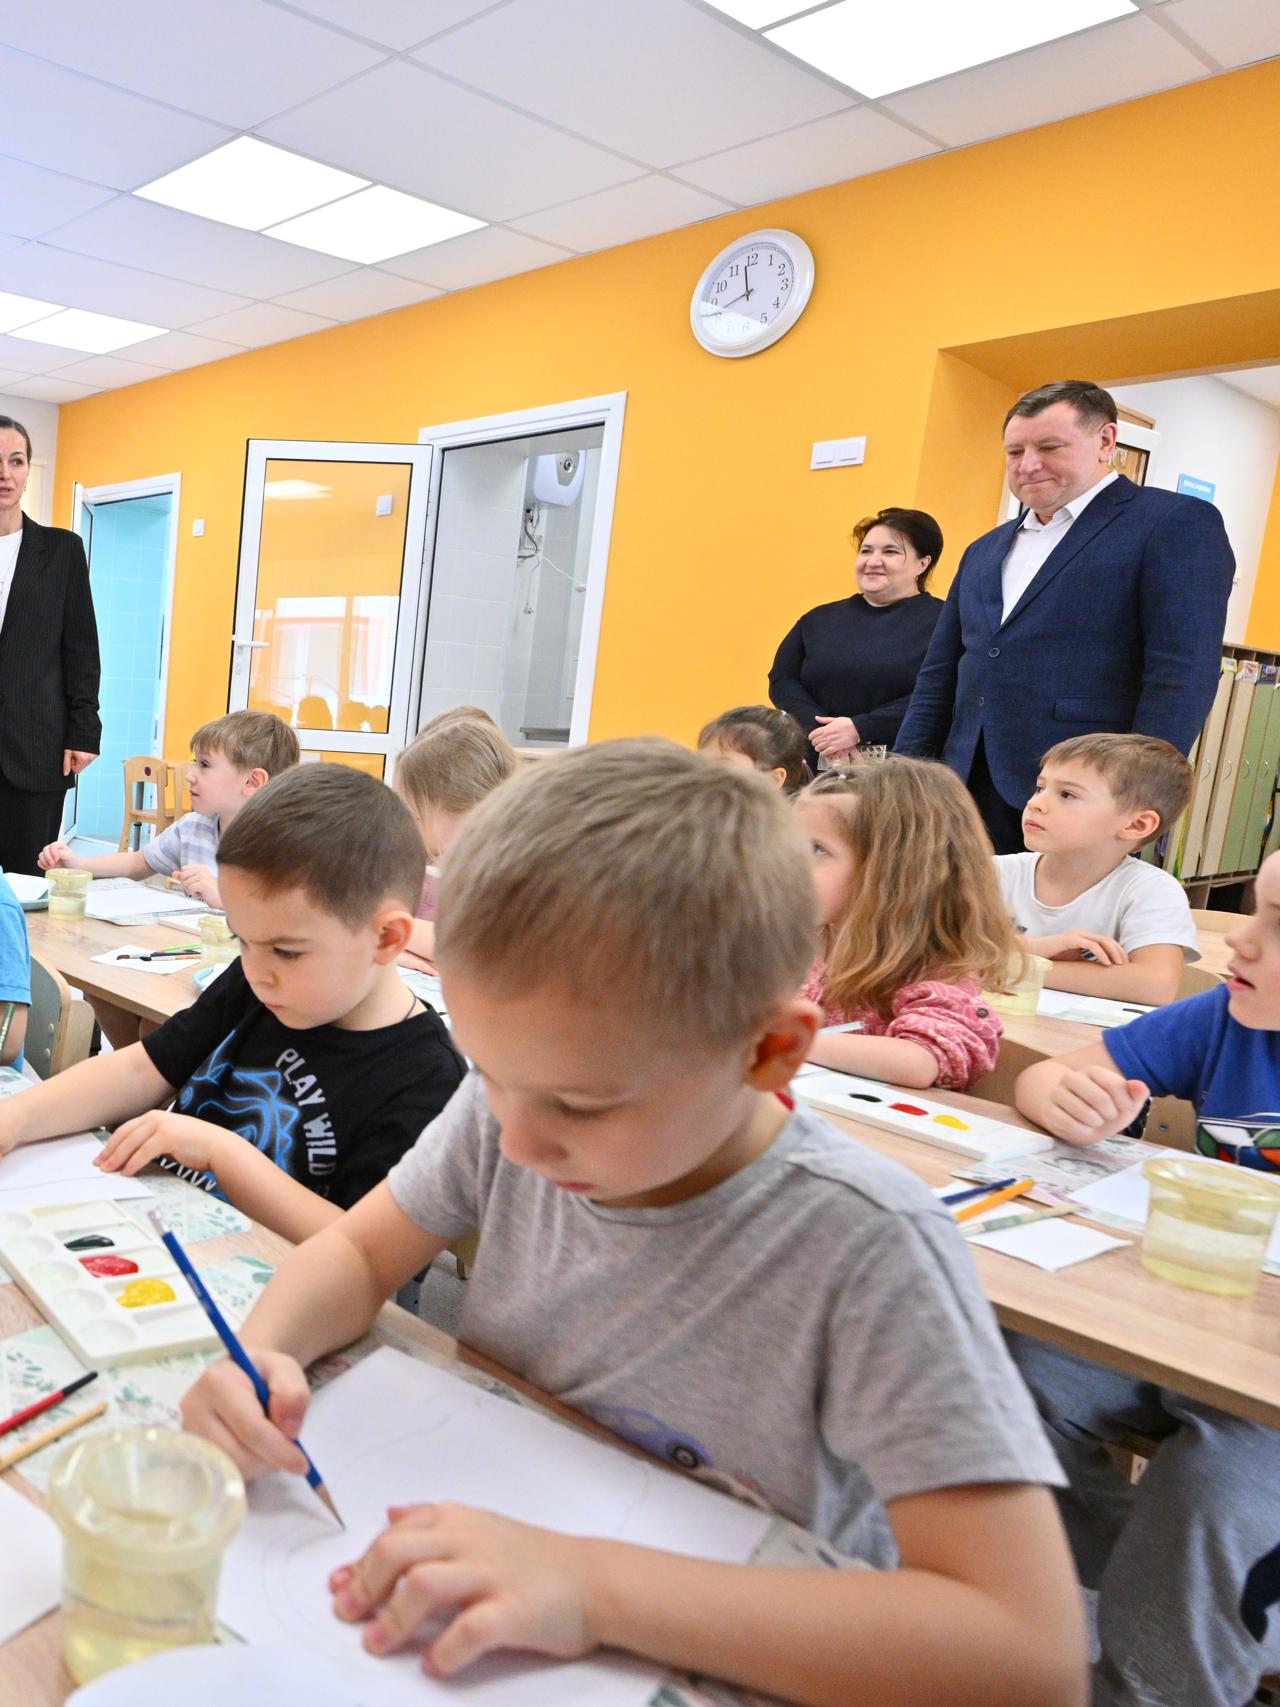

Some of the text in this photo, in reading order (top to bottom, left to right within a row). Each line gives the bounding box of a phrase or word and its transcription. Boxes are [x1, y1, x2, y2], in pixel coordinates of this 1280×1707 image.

[746, 253, 758, 267] 12
[768, 254, 773, 266] 1
[729, 265, 739, 277] 11
[778, 264, 785, 276] 2
[716, 280, 727, 293] 10
[781, 278, 788, 291] 3
[773, 297, 780, 308] 4
[760, 313, 768, 324] 5
[275, 1048, 337, 1176] PLAY WILD
